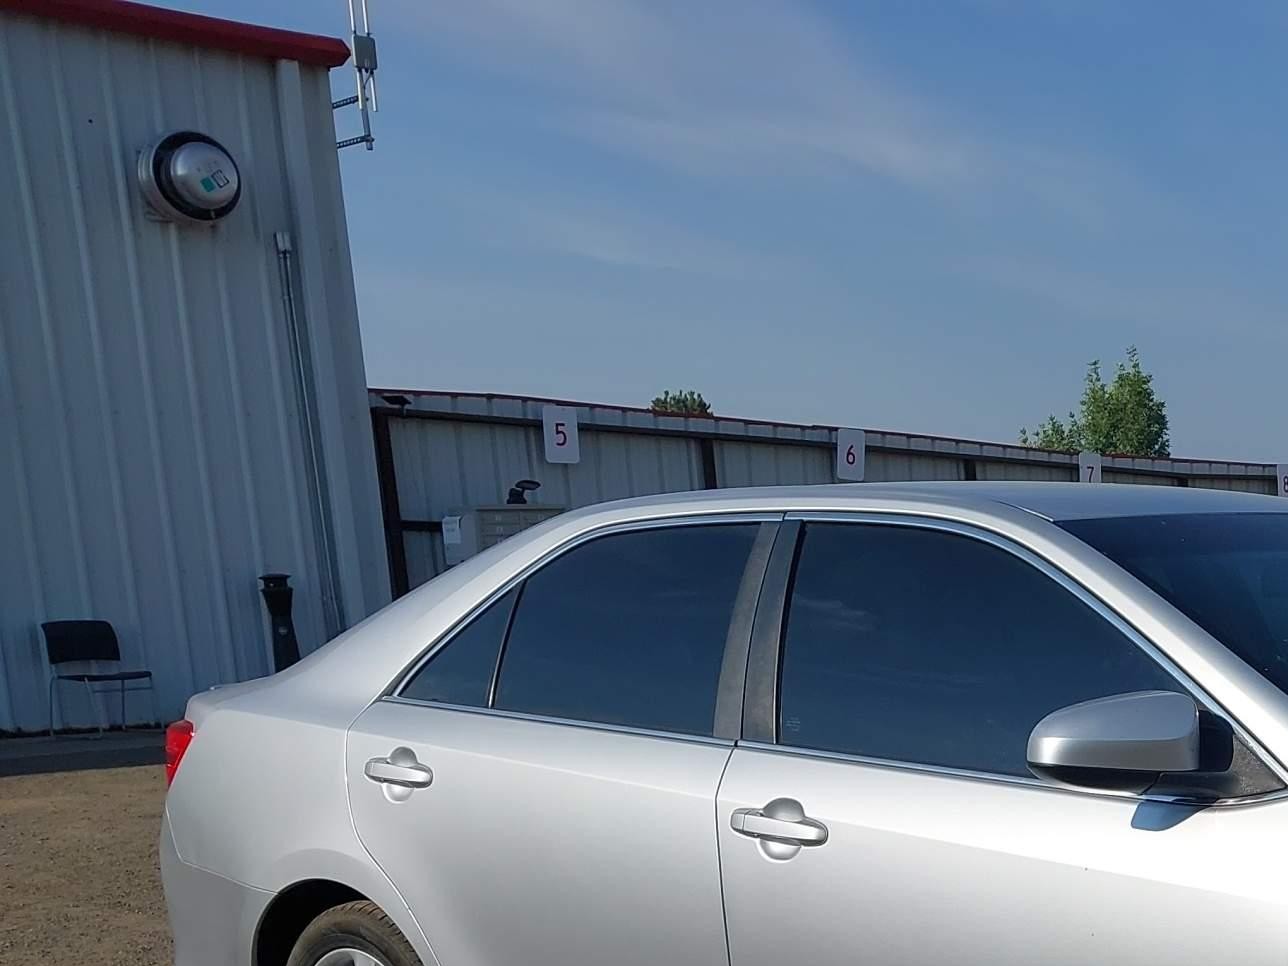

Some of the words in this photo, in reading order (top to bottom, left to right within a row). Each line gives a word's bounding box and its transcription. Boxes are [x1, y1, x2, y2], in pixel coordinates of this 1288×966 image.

[555, 422, 567, 447] 5
[846, 444, 856, 465] 6
[1086, 466, 1095, 483] 7
